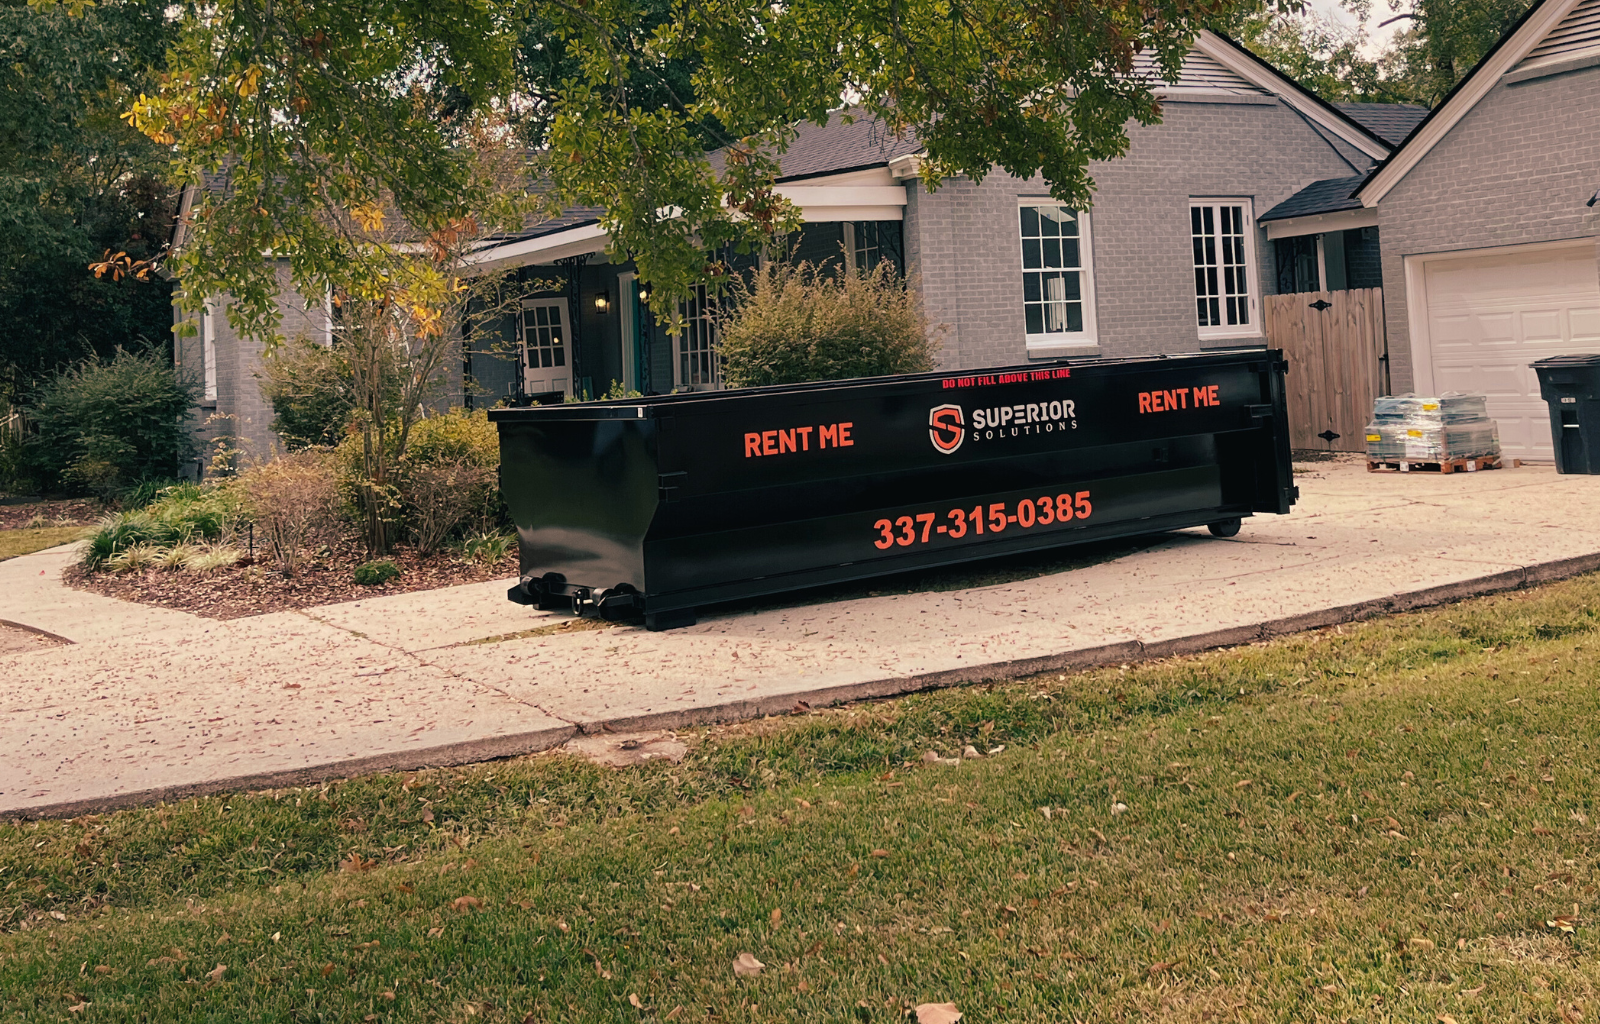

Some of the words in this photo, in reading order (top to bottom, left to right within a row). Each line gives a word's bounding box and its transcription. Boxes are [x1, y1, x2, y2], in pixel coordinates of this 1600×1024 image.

[942, 378, 956, 389] DO
[957, 377, 976, 388] NOT
[978, 375, 997, 386] FILL
[998, 373, 1029, 384] ABOVE
[1030, 370, 1050, 381] THIS
[1051, 368, 1071, 379] LINE
[972, 399, 1076, 430] SUPERIOR
[1138, 387, 1189, 414] RENT
[1193, 385, 1221, 408] ME
[744, 426, 813, 458] RENT
[818, 422, 855, 450] ME
[973, 420, 1078, 442] SOLUTIONS
[873, 490, 1093, 550] 337-315-0385
